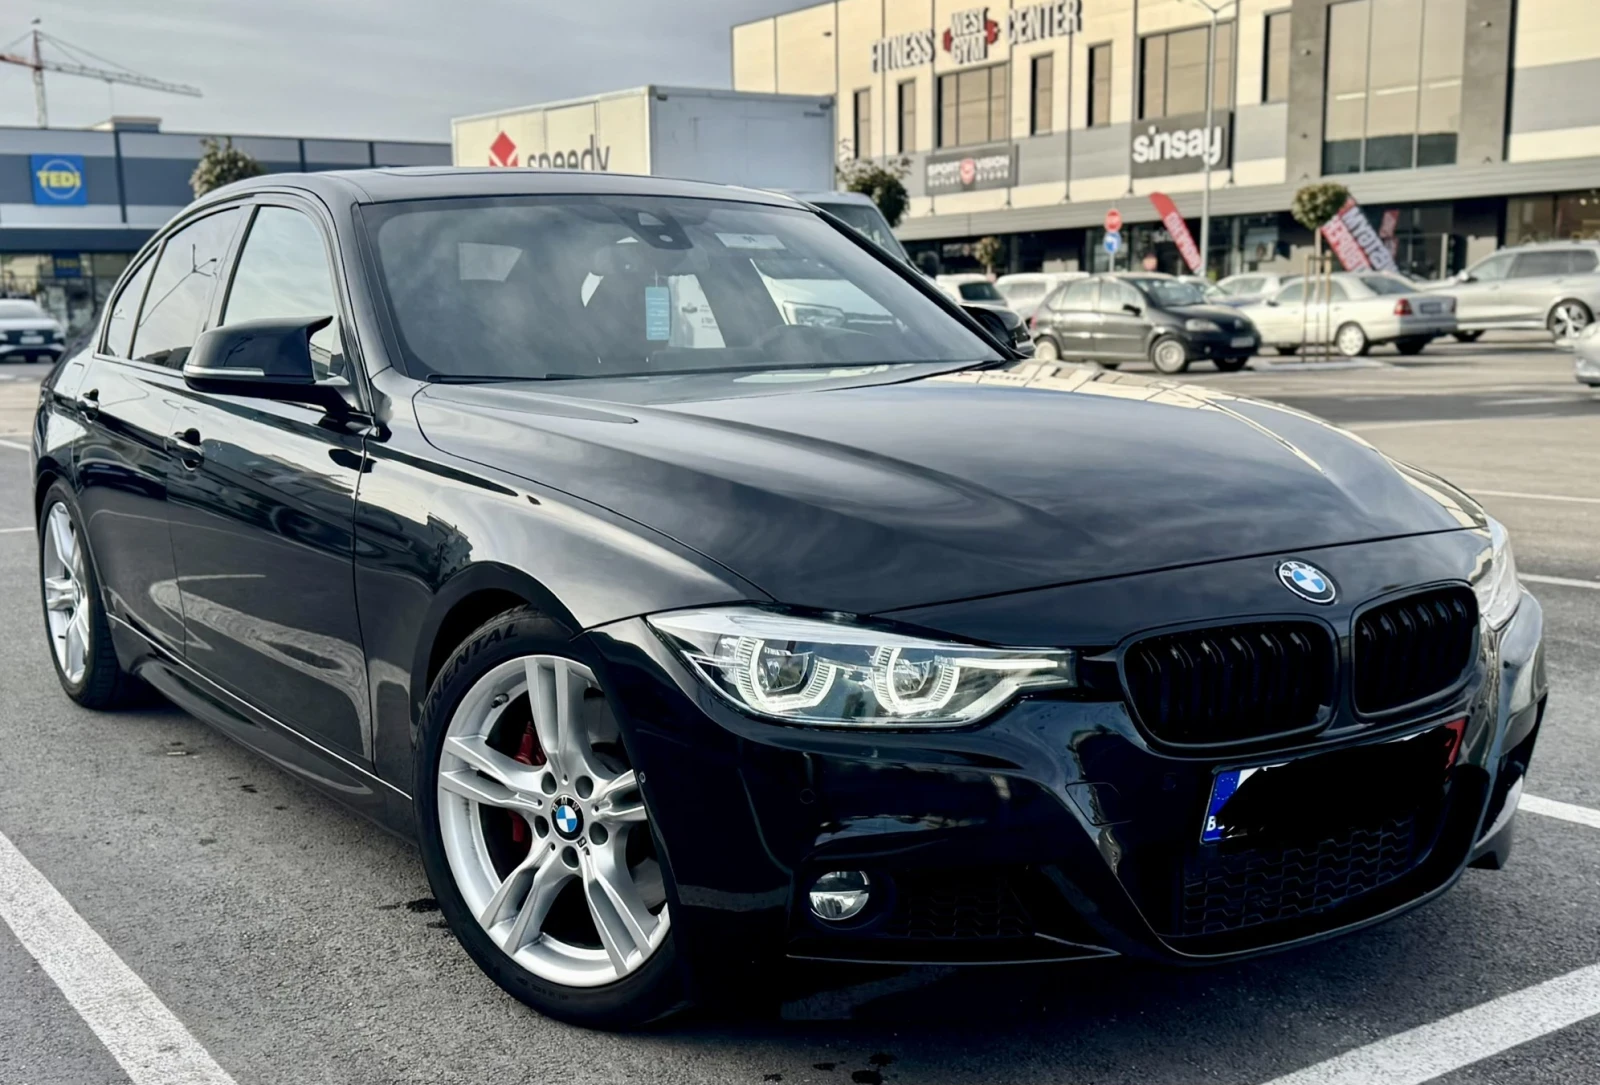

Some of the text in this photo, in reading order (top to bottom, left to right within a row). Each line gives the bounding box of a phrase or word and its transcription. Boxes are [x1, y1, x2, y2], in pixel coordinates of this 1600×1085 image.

[871, 0, 1082, 73] FITNESS CENTER
[951, 8, 989, 36] WEST
[951, 33, 988, 64] GYM
[1132, 125, 1222, 166] sinsay
[928, 155, 1010, 176] SPORT VISION
